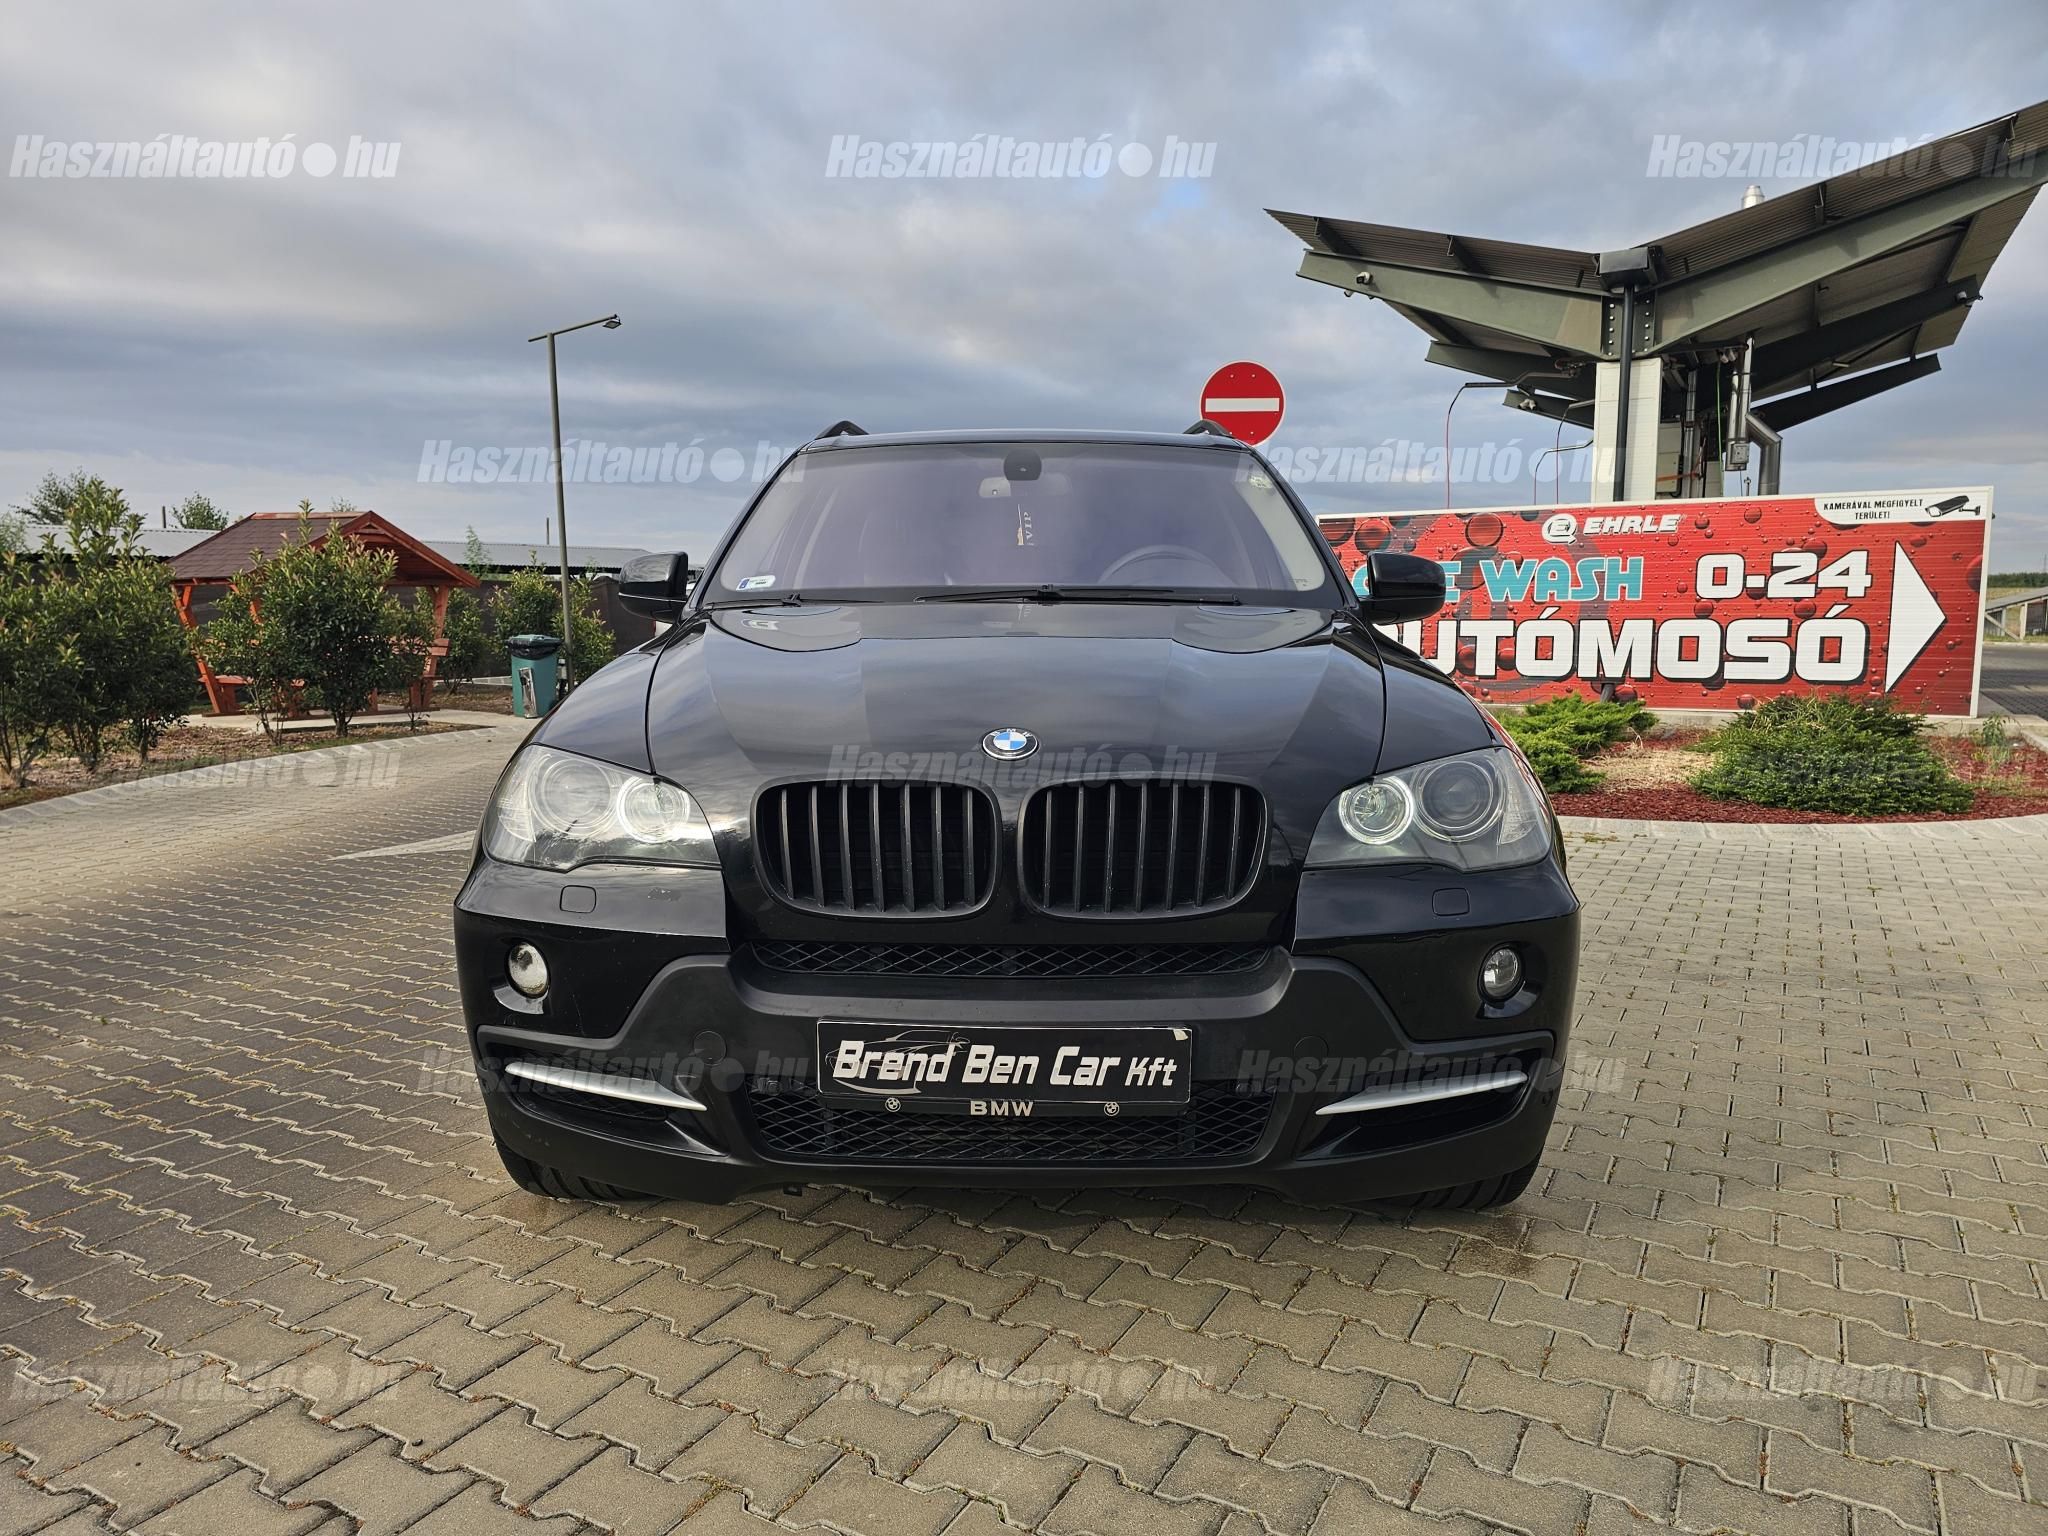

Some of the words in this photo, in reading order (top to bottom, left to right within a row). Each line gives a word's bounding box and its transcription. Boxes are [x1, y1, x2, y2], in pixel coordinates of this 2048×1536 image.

[1583, 514, 1681, 535] EHRLE
[1823, 500, 1871, 511] KAMERÁVAL
[1873, 498, 1923, 509] MEGFIGYELT
[1479, 556, 1644, 602] WASH
[1695, 550, 1873, 600] 0-24
[1372, 603, 1870, 684] UTÓMOSÓ
[962, 1044, 1040, 1085] Ben
[1050, 1045, 1121, 1087] Car
[1125, 1057, 1177, 1087] Kft
[970, 1101, 1034, 1117] BMW
